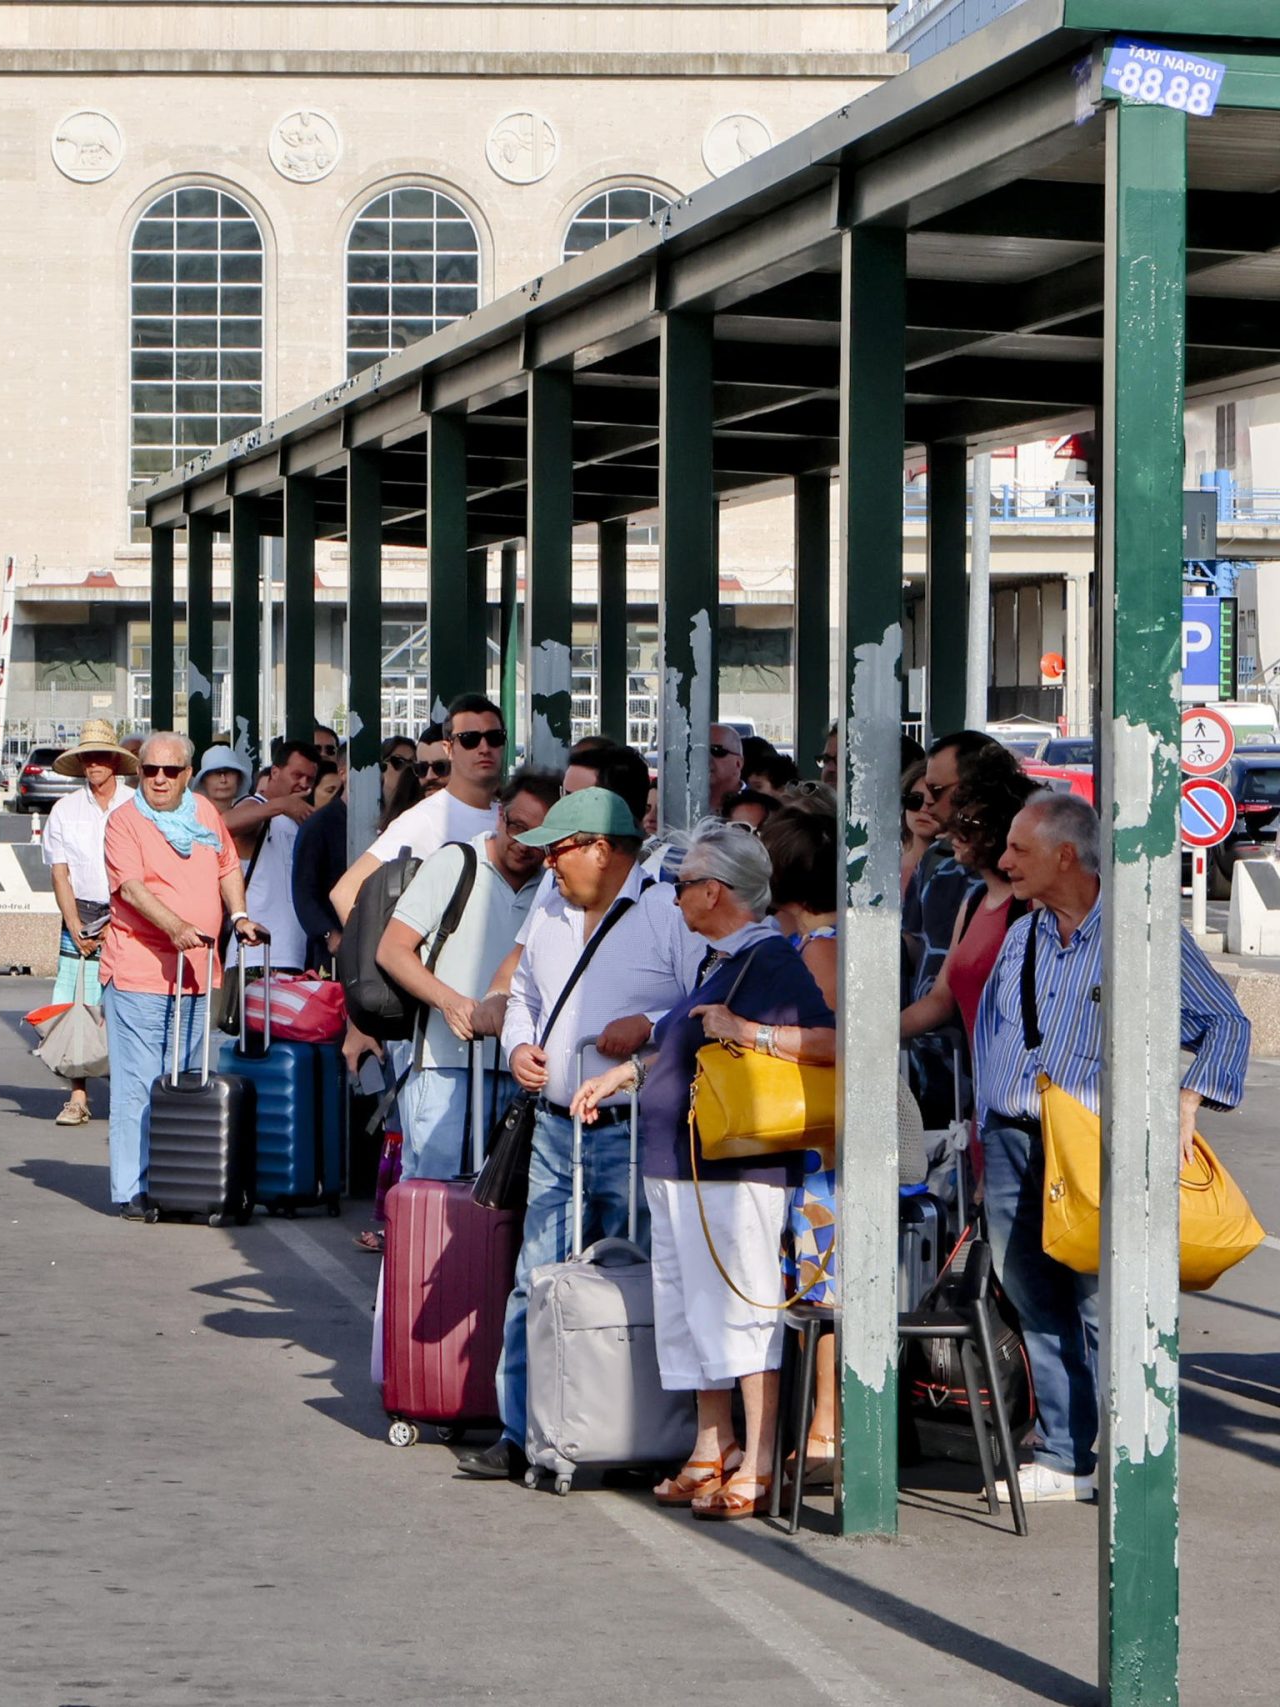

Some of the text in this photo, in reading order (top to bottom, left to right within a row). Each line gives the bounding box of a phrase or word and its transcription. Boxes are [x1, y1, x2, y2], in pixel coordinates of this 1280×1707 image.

[1128, 44, 1217, 81] TAXI NAPOLI
[1118, 61, 1211, 115] 88.88
[1181, 621, 1213, 669] P
